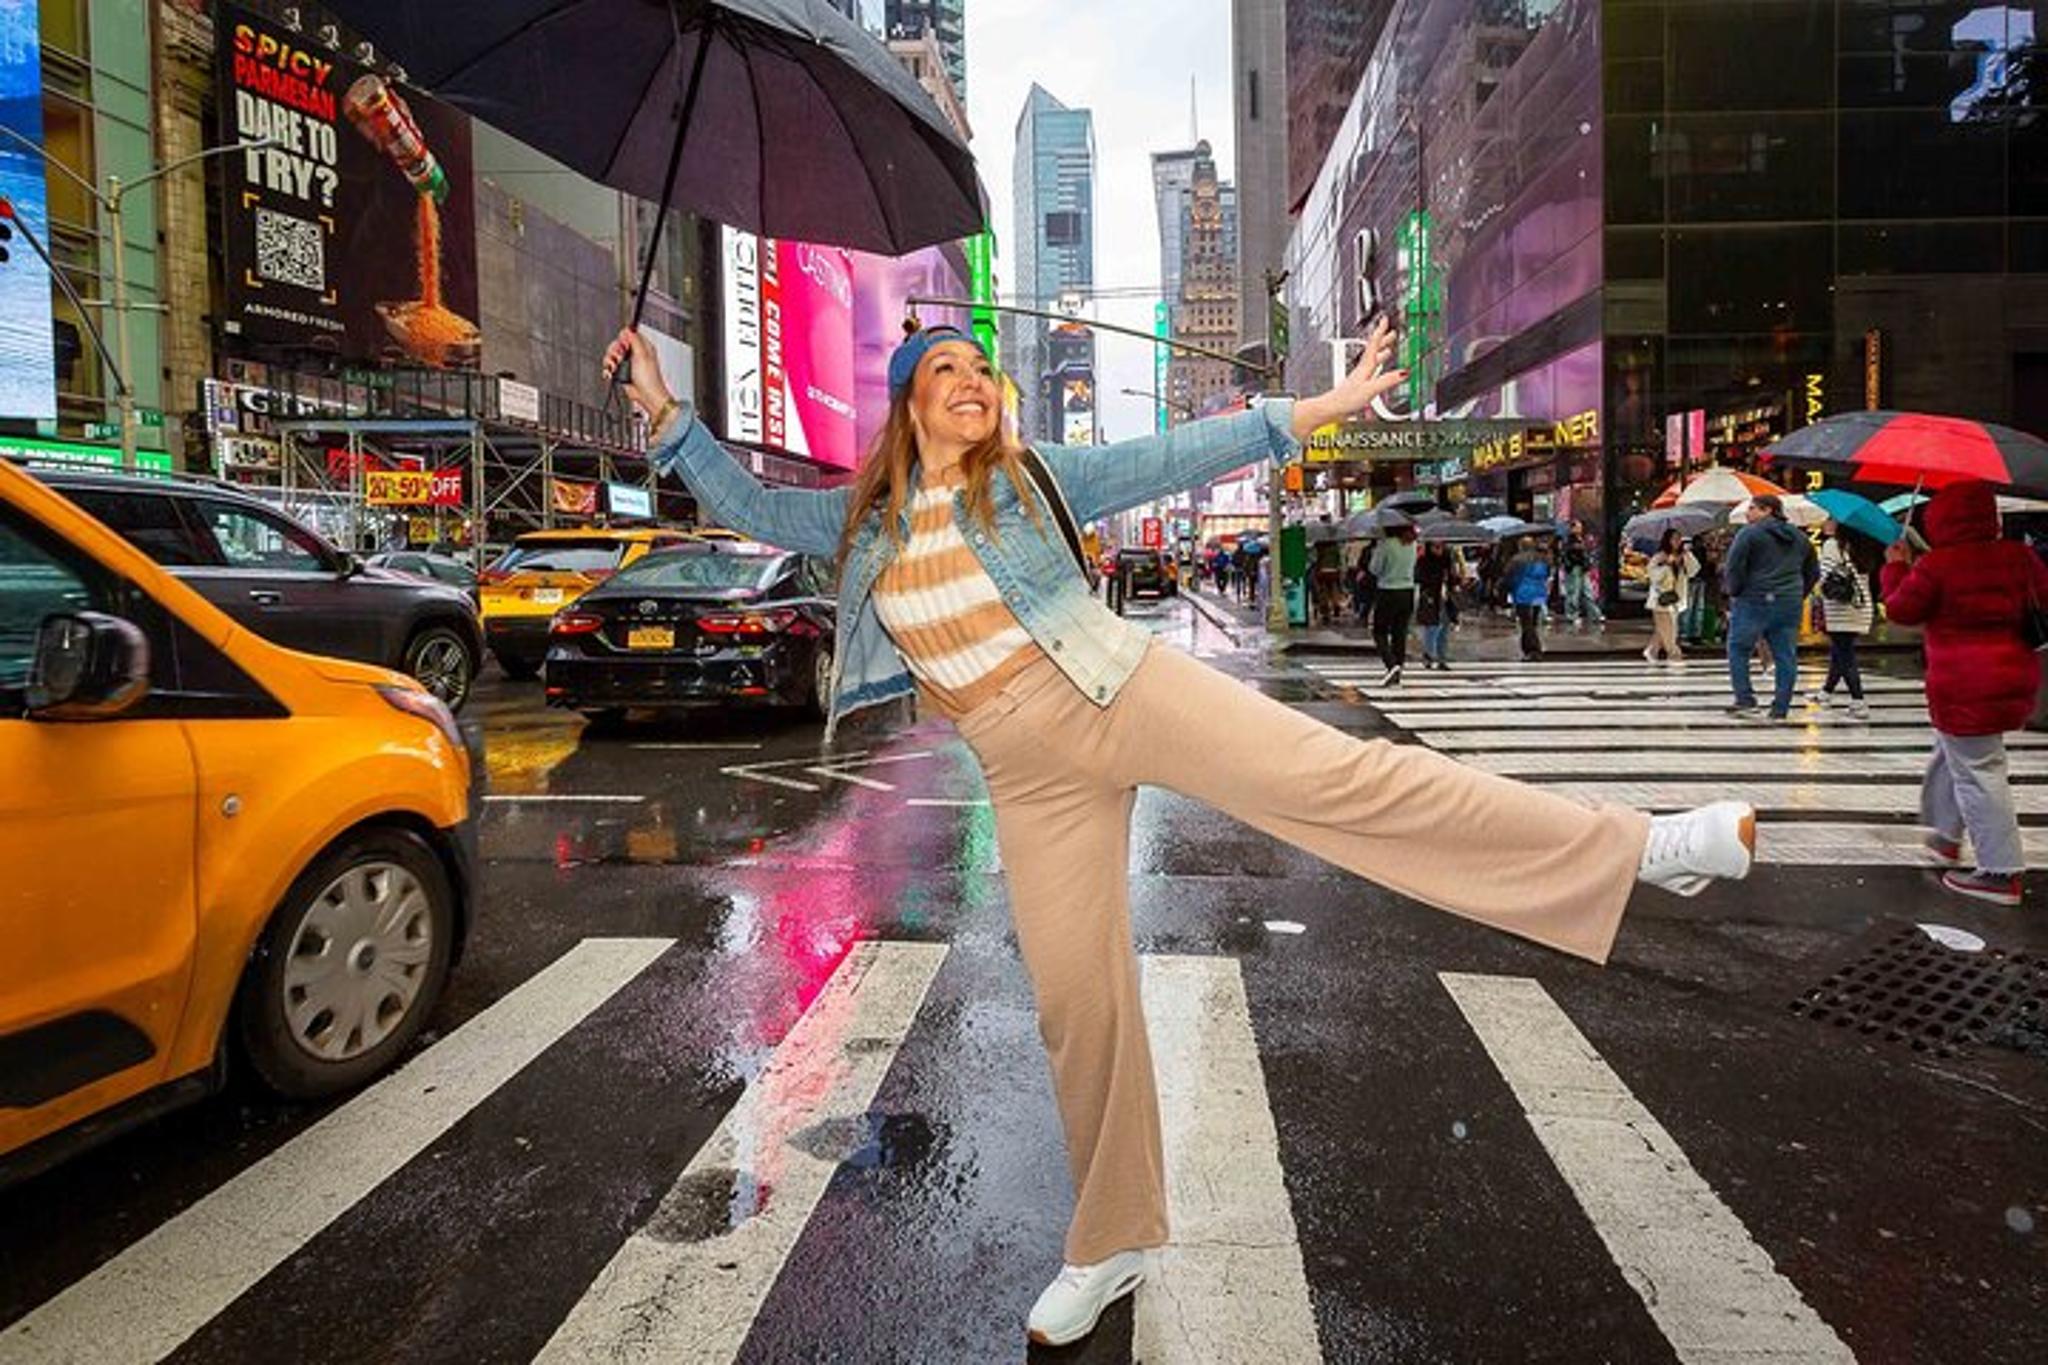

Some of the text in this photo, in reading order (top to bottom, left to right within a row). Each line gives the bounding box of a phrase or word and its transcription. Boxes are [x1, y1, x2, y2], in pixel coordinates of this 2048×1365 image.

[233, 24, 332, 86] SPICY
[235, 52, 336, 121] PARMESAN
[236, 89, 337, 166] DARE TO
[239, 136, 339, 207] TRY?
[243, 303, 308, 325] ARMORED
[764, 298, 784, 380] COME
[1473, 441, 1506, 469] MAX
[1508, 411, 1598, 459] BNER
[431, 477, 461, 497] OFF
